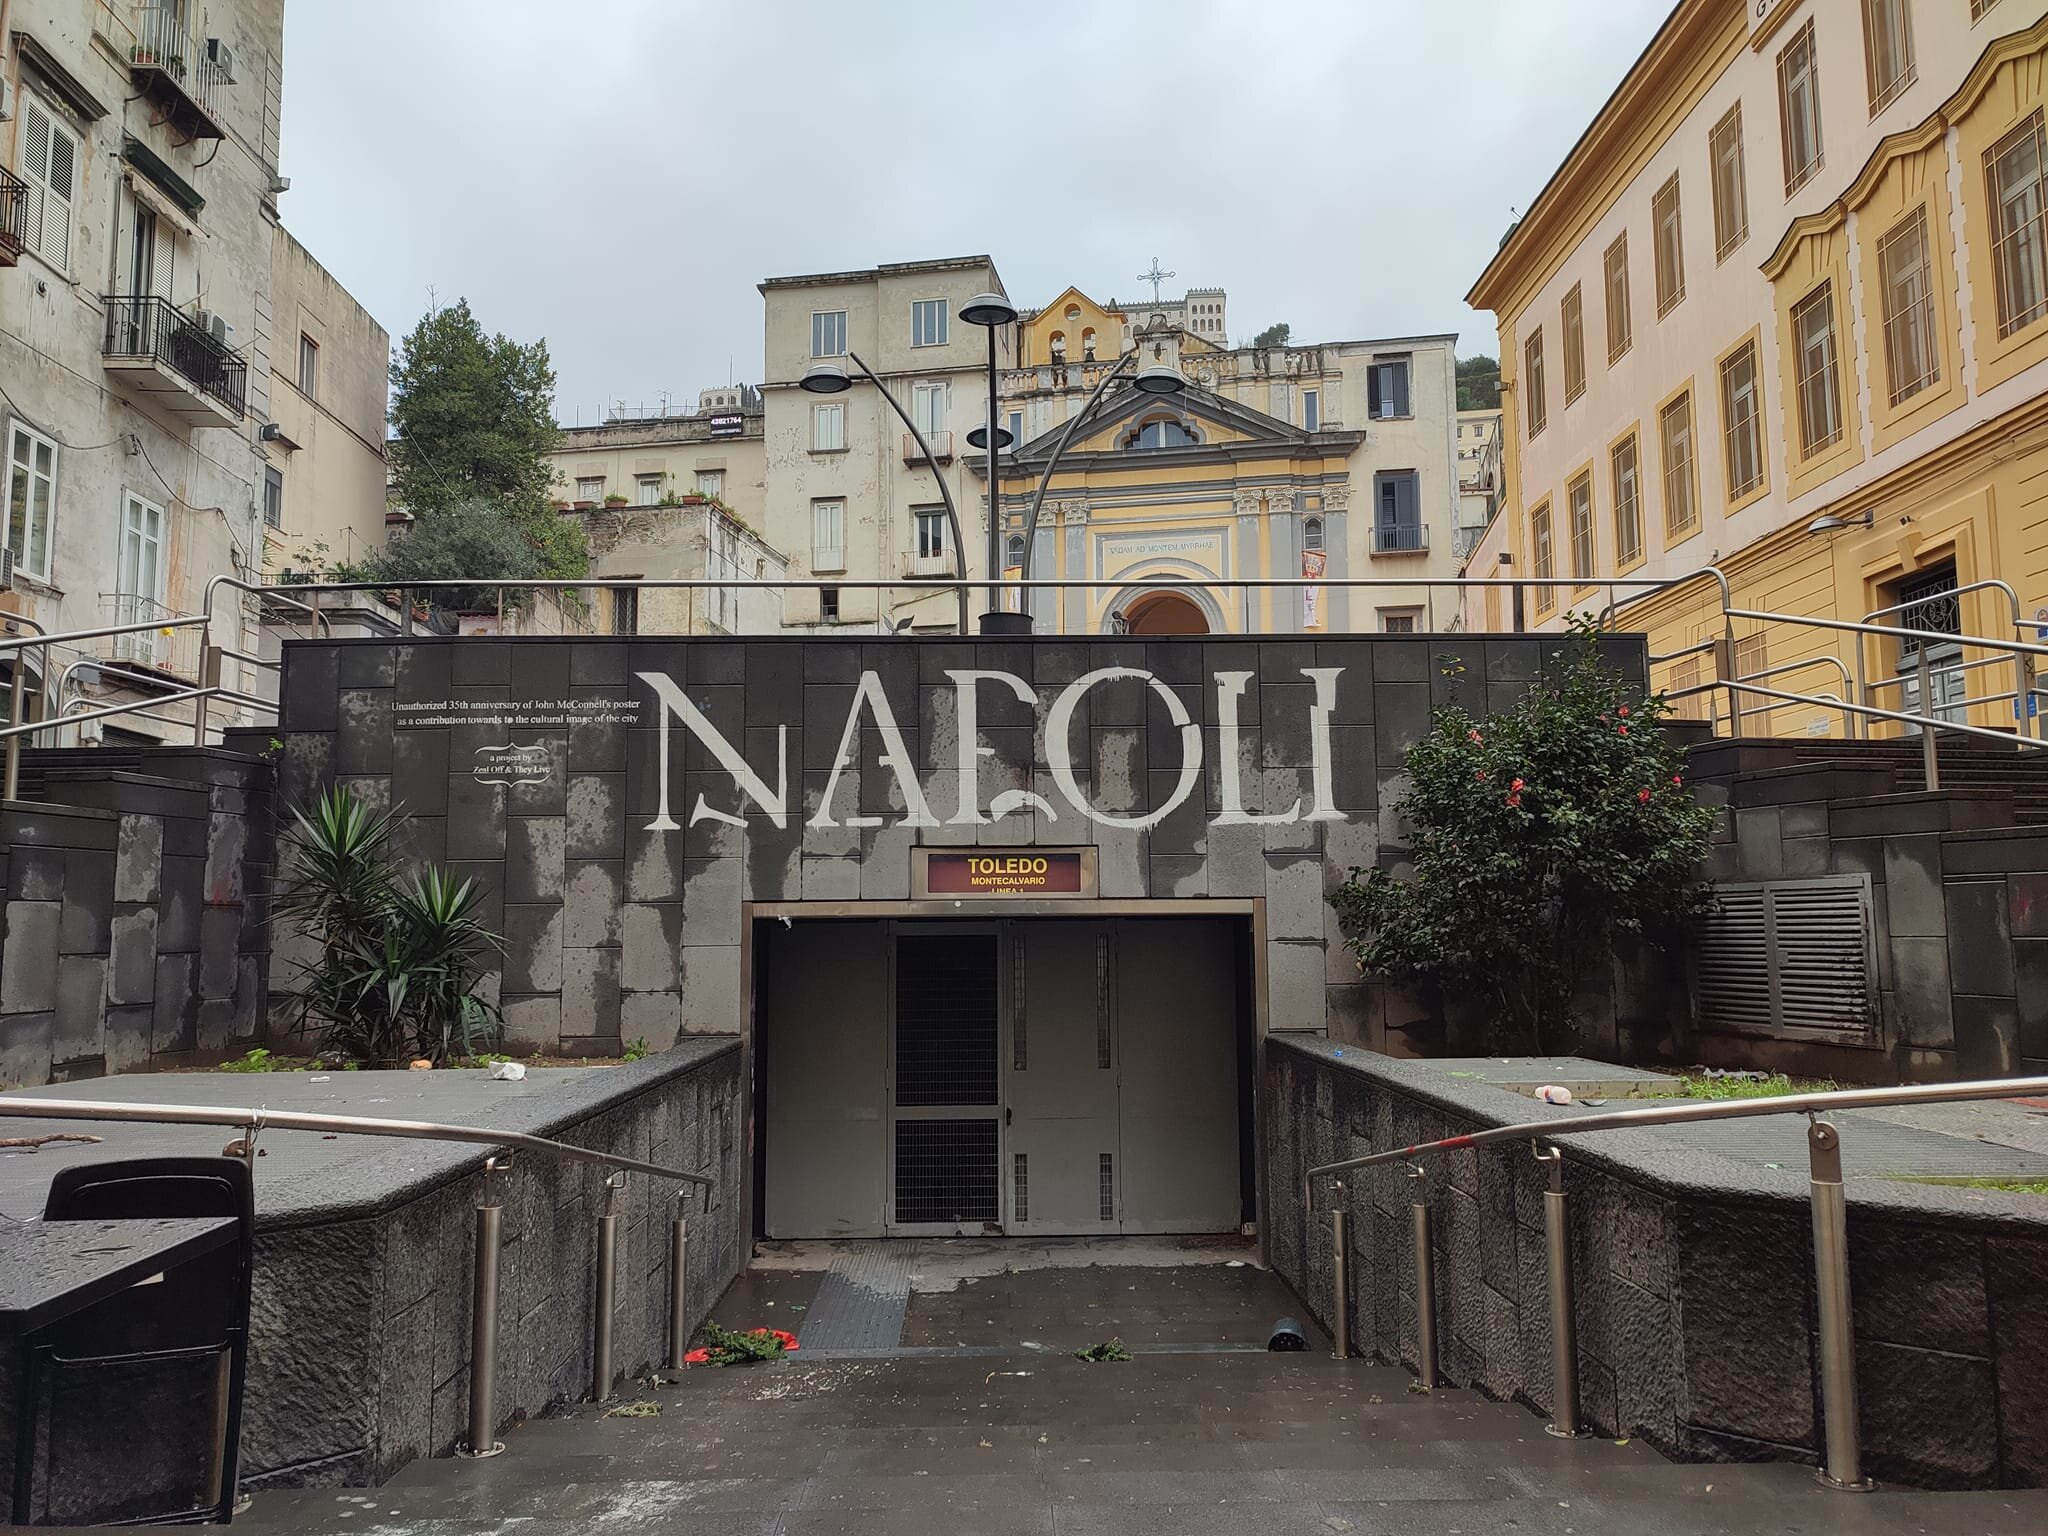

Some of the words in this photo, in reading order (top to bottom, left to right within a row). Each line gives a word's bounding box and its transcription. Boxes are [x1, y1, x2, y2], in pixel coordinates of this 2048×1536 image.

[391, 701, 447, 711] Unauthorized
[448, 700, 469, 710] 35th
[470, 700, 521, 711] anniversary
[522, 700, 533, 709] of
[534, 700, 555, 709] John
[557, 699, 611, 709] McConnell's
[613, 701, 640, 710] poster
[397, 718, 406, 726] as
[415, 715, 467, 725] contribution
[468, 715, 502, 724] towards
[504, 716, 514, 724] to
[515, 714, 529, 724] the
[530, 714, 564, 724] cultural
[566, 714, 593, 725] image
[594, 713, 605, 723] of
[606, 713, 620, 723] the
[621, 713, 639, 724] city
[634, 666, 1348, 831] NAPOLI
[496, 753, 521, 763] project
[522, 753, 533, 763] by
[513, 765, 533, 775] They
[533, 765, 551, 774] Live
[968, 858, 1048, 874] TOLEDO
[971, 877, 1045, 885] MONTECALVARIO
